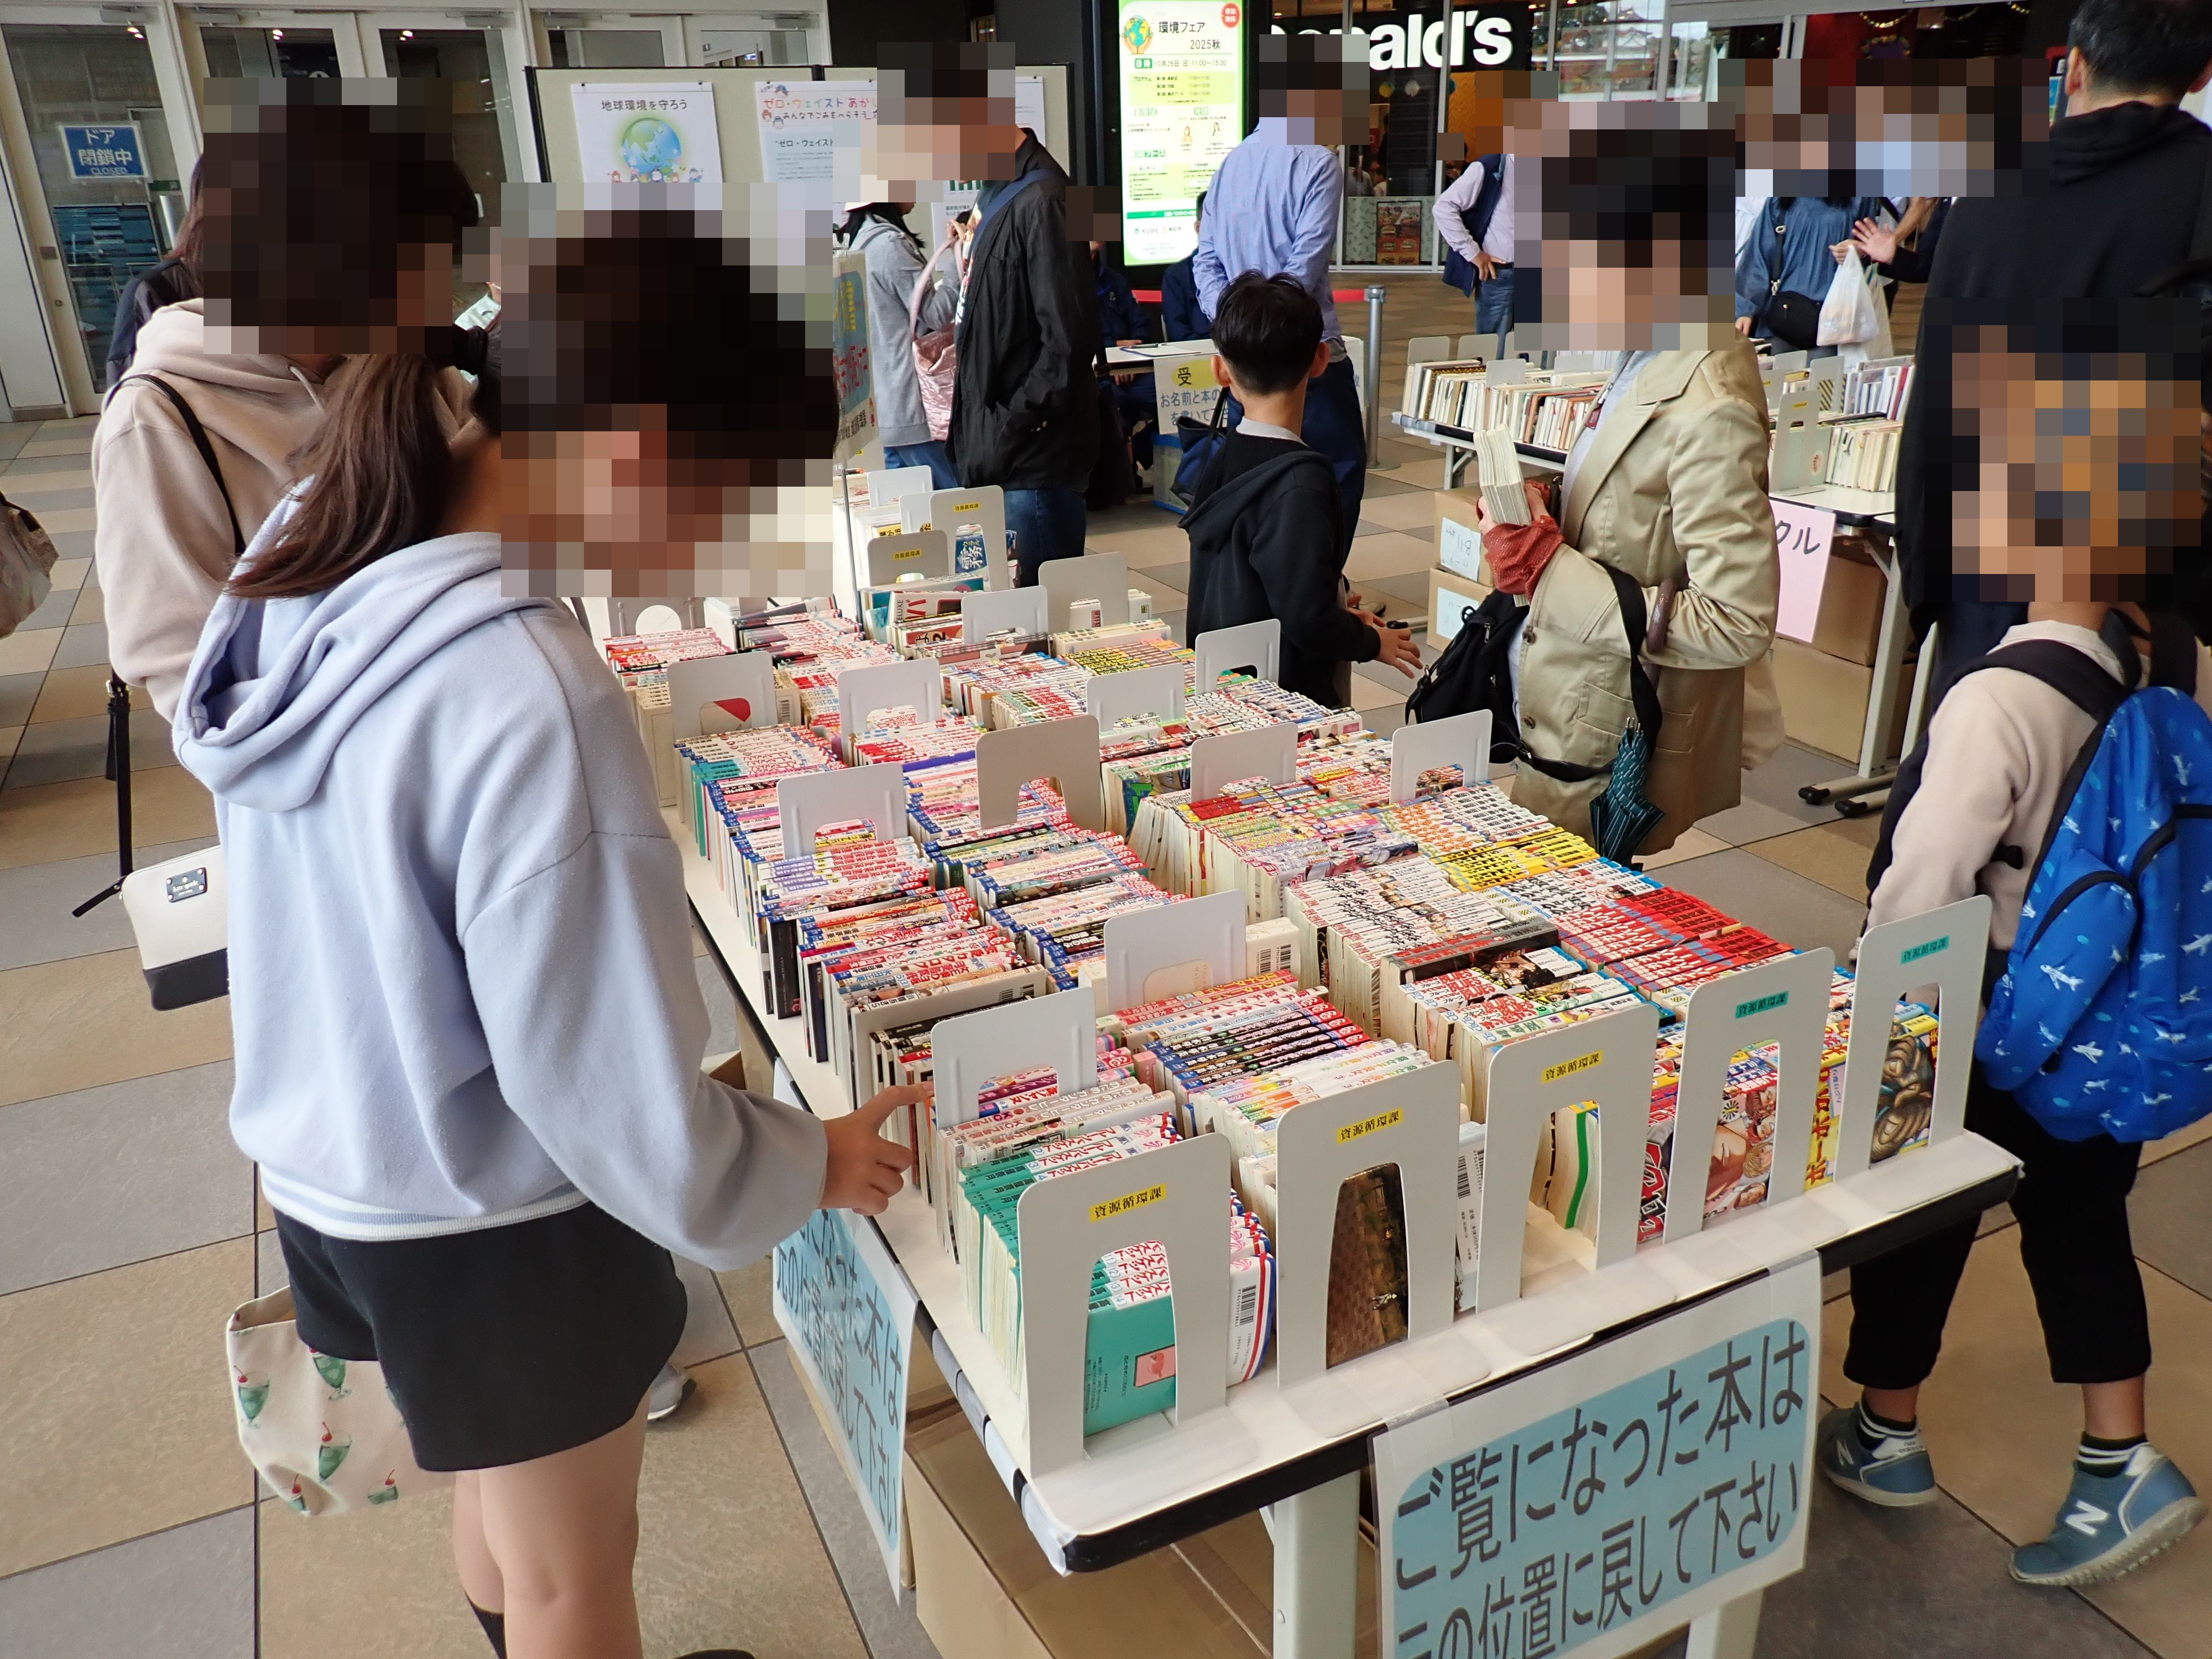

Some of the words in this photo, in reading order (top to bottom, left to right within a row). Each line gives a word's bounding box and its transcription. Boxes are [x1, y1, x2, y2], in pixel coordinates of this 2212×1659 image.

[1159, 22, 1205, 33] 環境フェア
[1191, 39, 1220, 49] 2025秋
[602, 99, 687, 111] 地球環境を守ろう
[764, 98, 843, 109] ゼロ・ウェイスト
[86, 129, 116, 145] ドア
[78, 148, 133, 166] 閉鎖中
[1178, 367, 1192, 386] 受
[1438, 968, 1474, 984] BLUES
[1447, 976, 1483, 992] BLUES
[1460, 983, 1496, 1000] BLUES
[1545, 1052, 1600, 1082] 資源循環課
[1028, 1080, 1120, 1112] のだめカンタービレ
[1041, 1088, 1131, 1120] のだめカンタービレ
[1340, 1110, 1400, 1141] 資源循環課
[1042, 1126, 1117, 1154] フルーツバスケット
[1038, 1139, 1114, 1168] フルーツバスケット
[1047, 1150, 1123, 1179] フルーツバスケット
[1094, 1186, 1162, 1218] 資源循環課
[1396, 1321, 1805, 1590] ご覧になった本は
[2065, 1500, 2109, 1537] N
